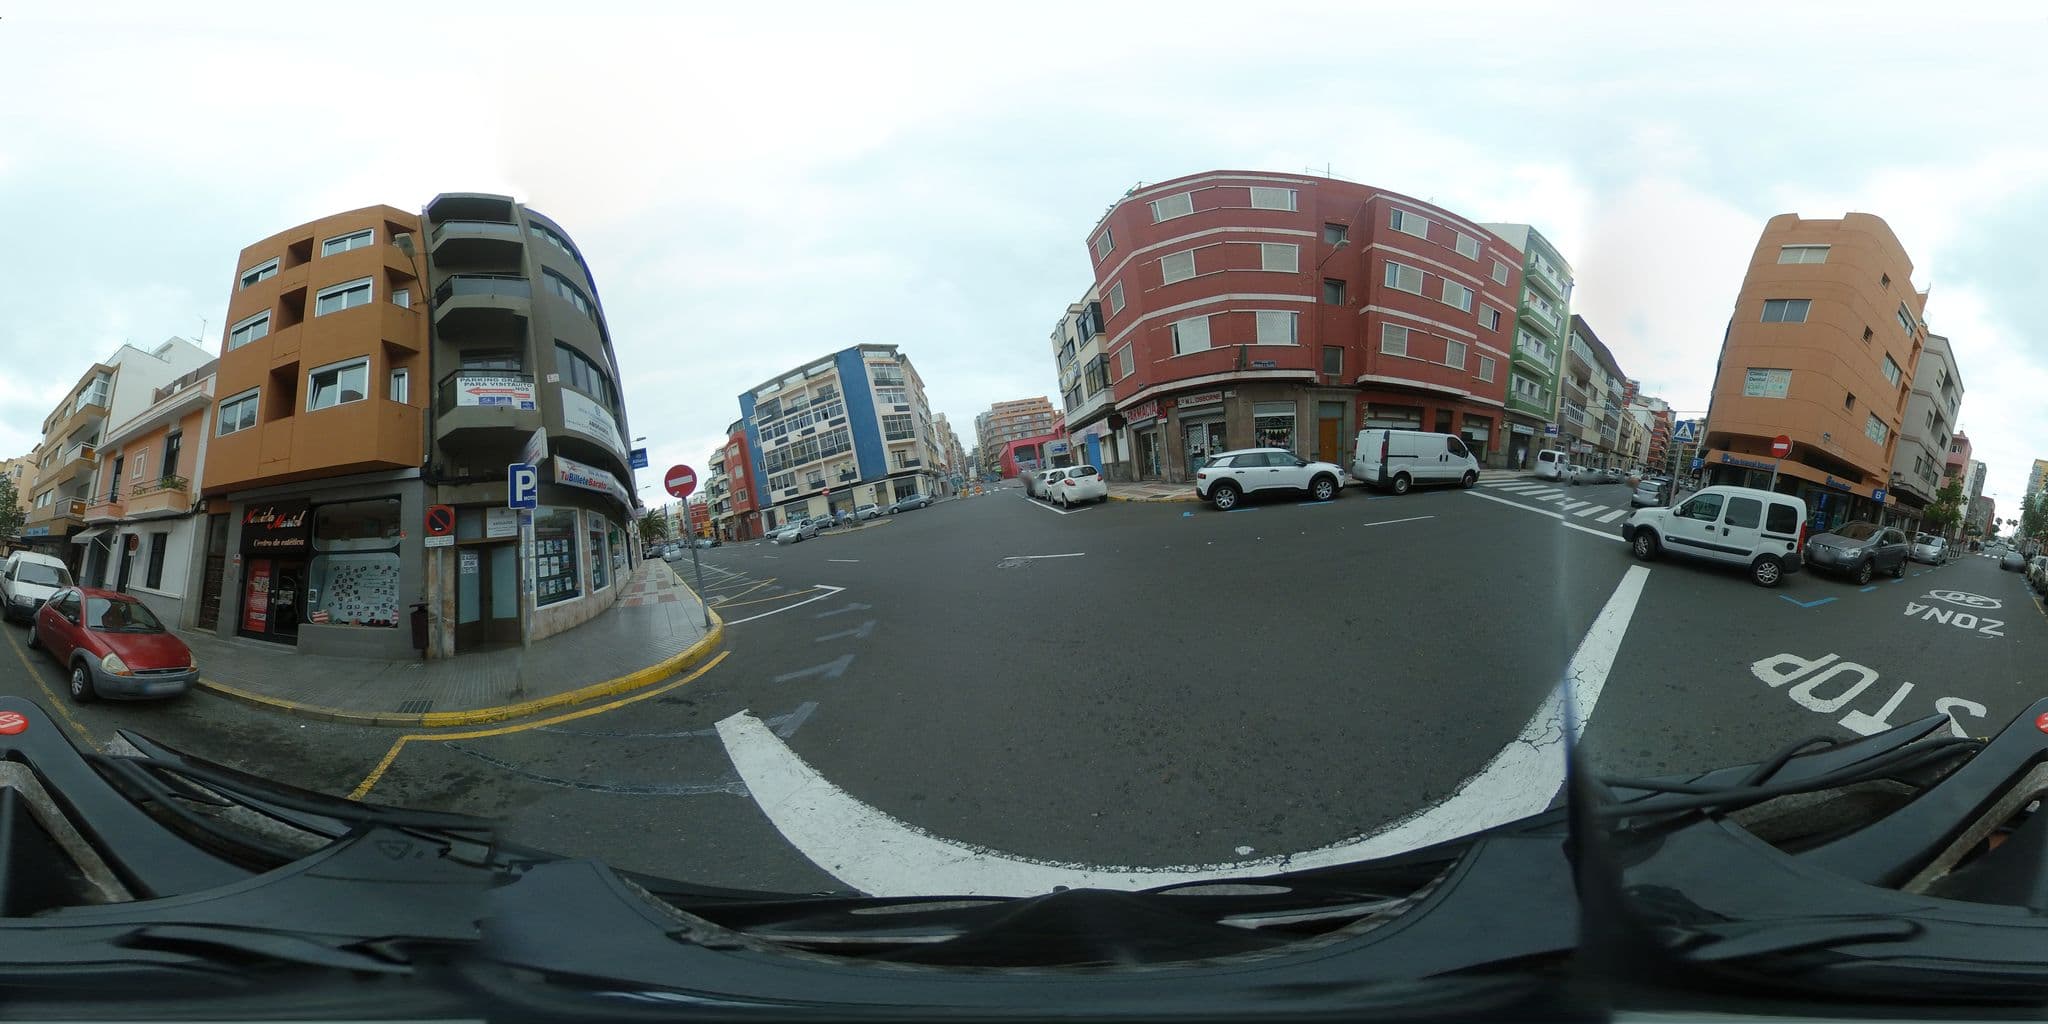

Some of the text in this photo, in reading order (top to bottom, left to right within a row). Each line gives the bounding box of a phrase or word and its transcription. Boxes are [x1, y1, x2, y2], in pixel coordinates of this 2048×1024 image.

[1127, 401, 1157, 420] FARMACIA
[515, 470, 537, 502] P
[1903, 601, 2005, 636] ZONA
[1750, 653, 1988, 738] STOP
